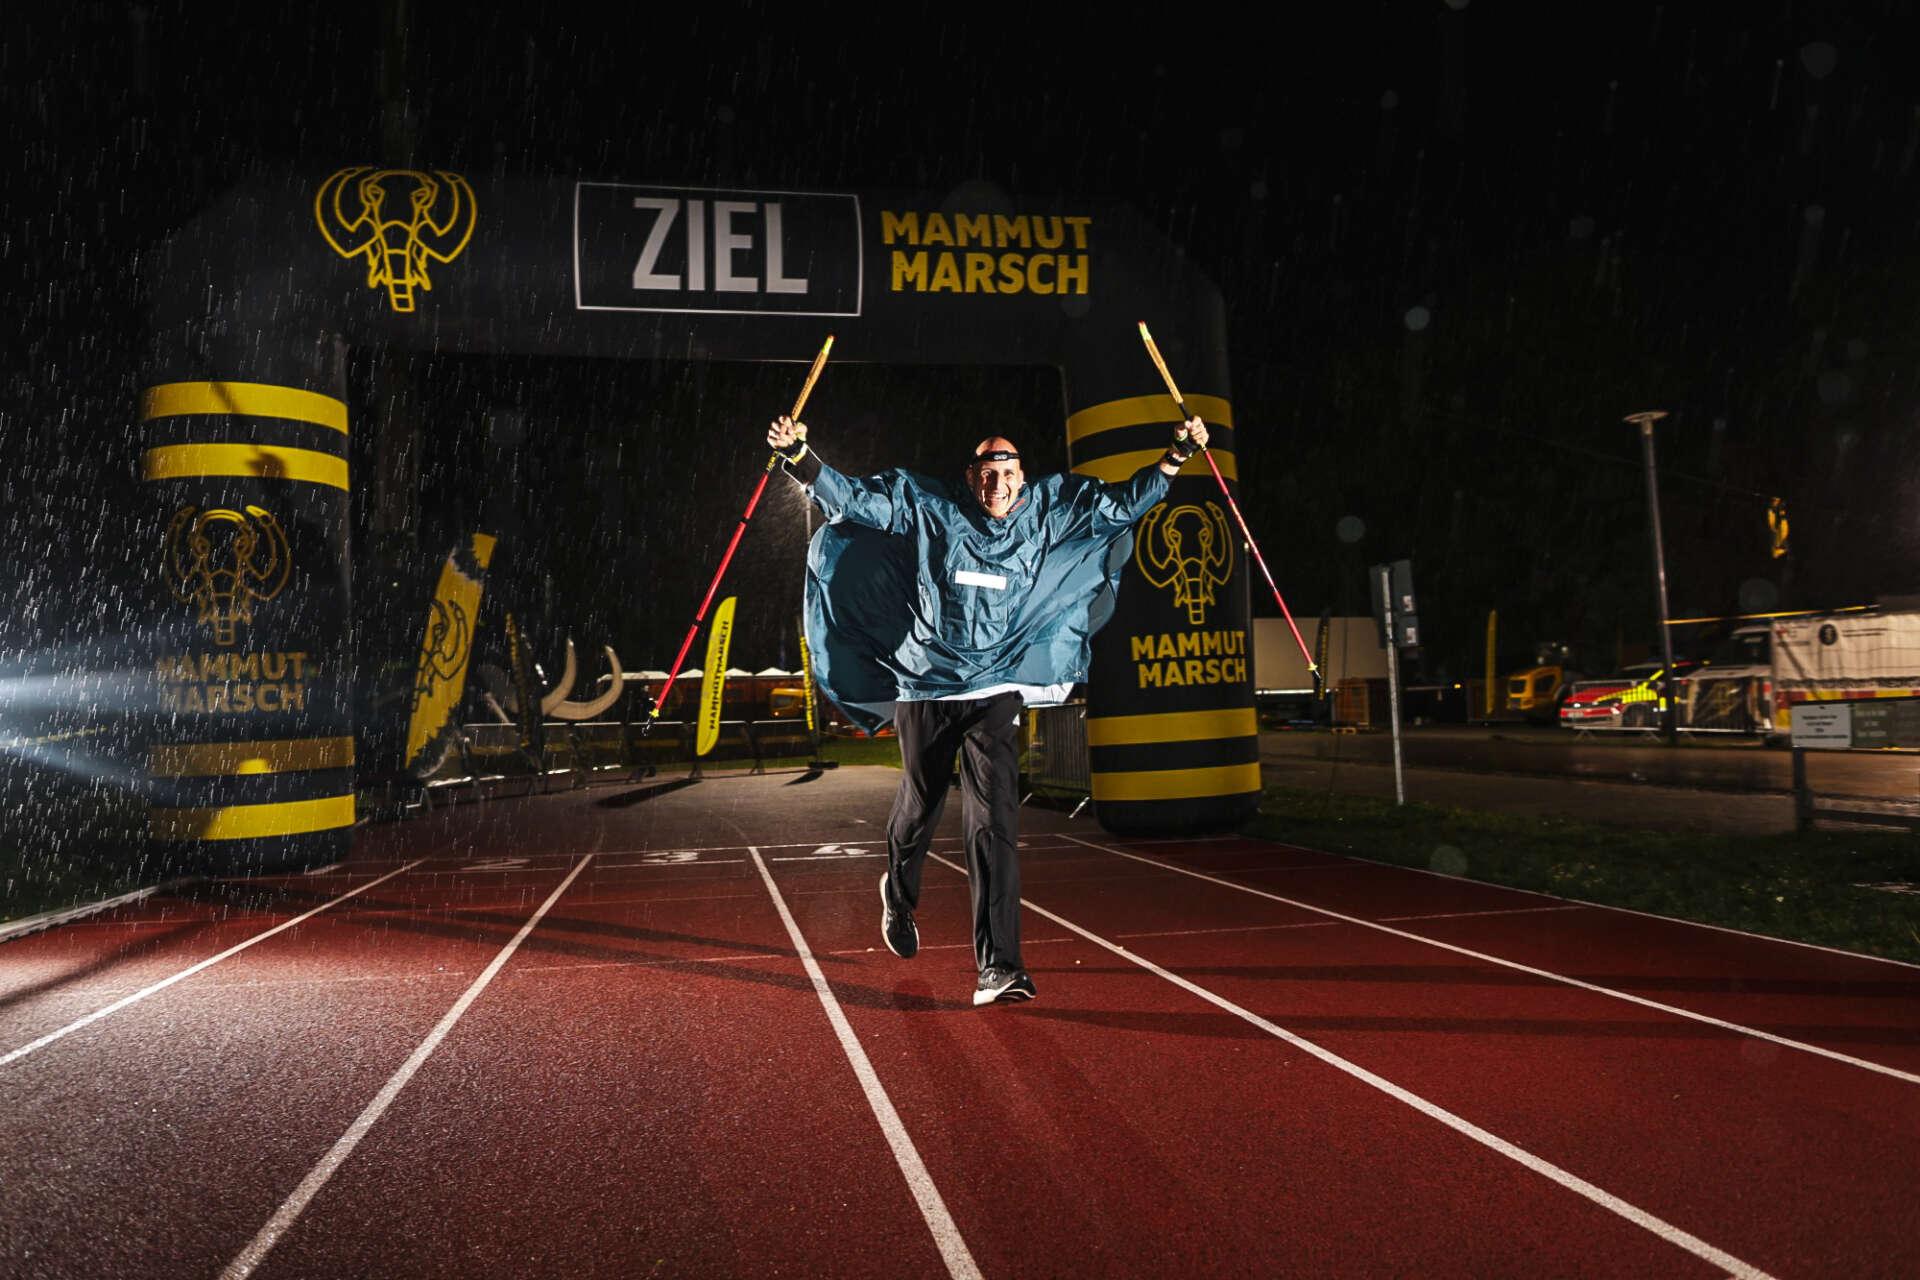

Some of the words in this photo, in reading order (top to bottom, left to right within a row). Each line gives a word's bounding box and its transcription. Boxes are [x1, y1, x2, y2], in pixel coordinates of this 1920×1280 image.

[632, 197, 809, 293] ZIEL
[881, 210, 1092, 250] MAMMUT
[891, 250, 1090, 295] MARSCH
[1131, 630, 1246, 661] MAMMUT
[156, 652, 307, 682] MAMMUT
[1138, 658, 1248, 688] MARSCH
[160, 683, 305, 715] MARSCH
[641, 851, 699, 863] 3
[811, 845, 870, 855] 4
